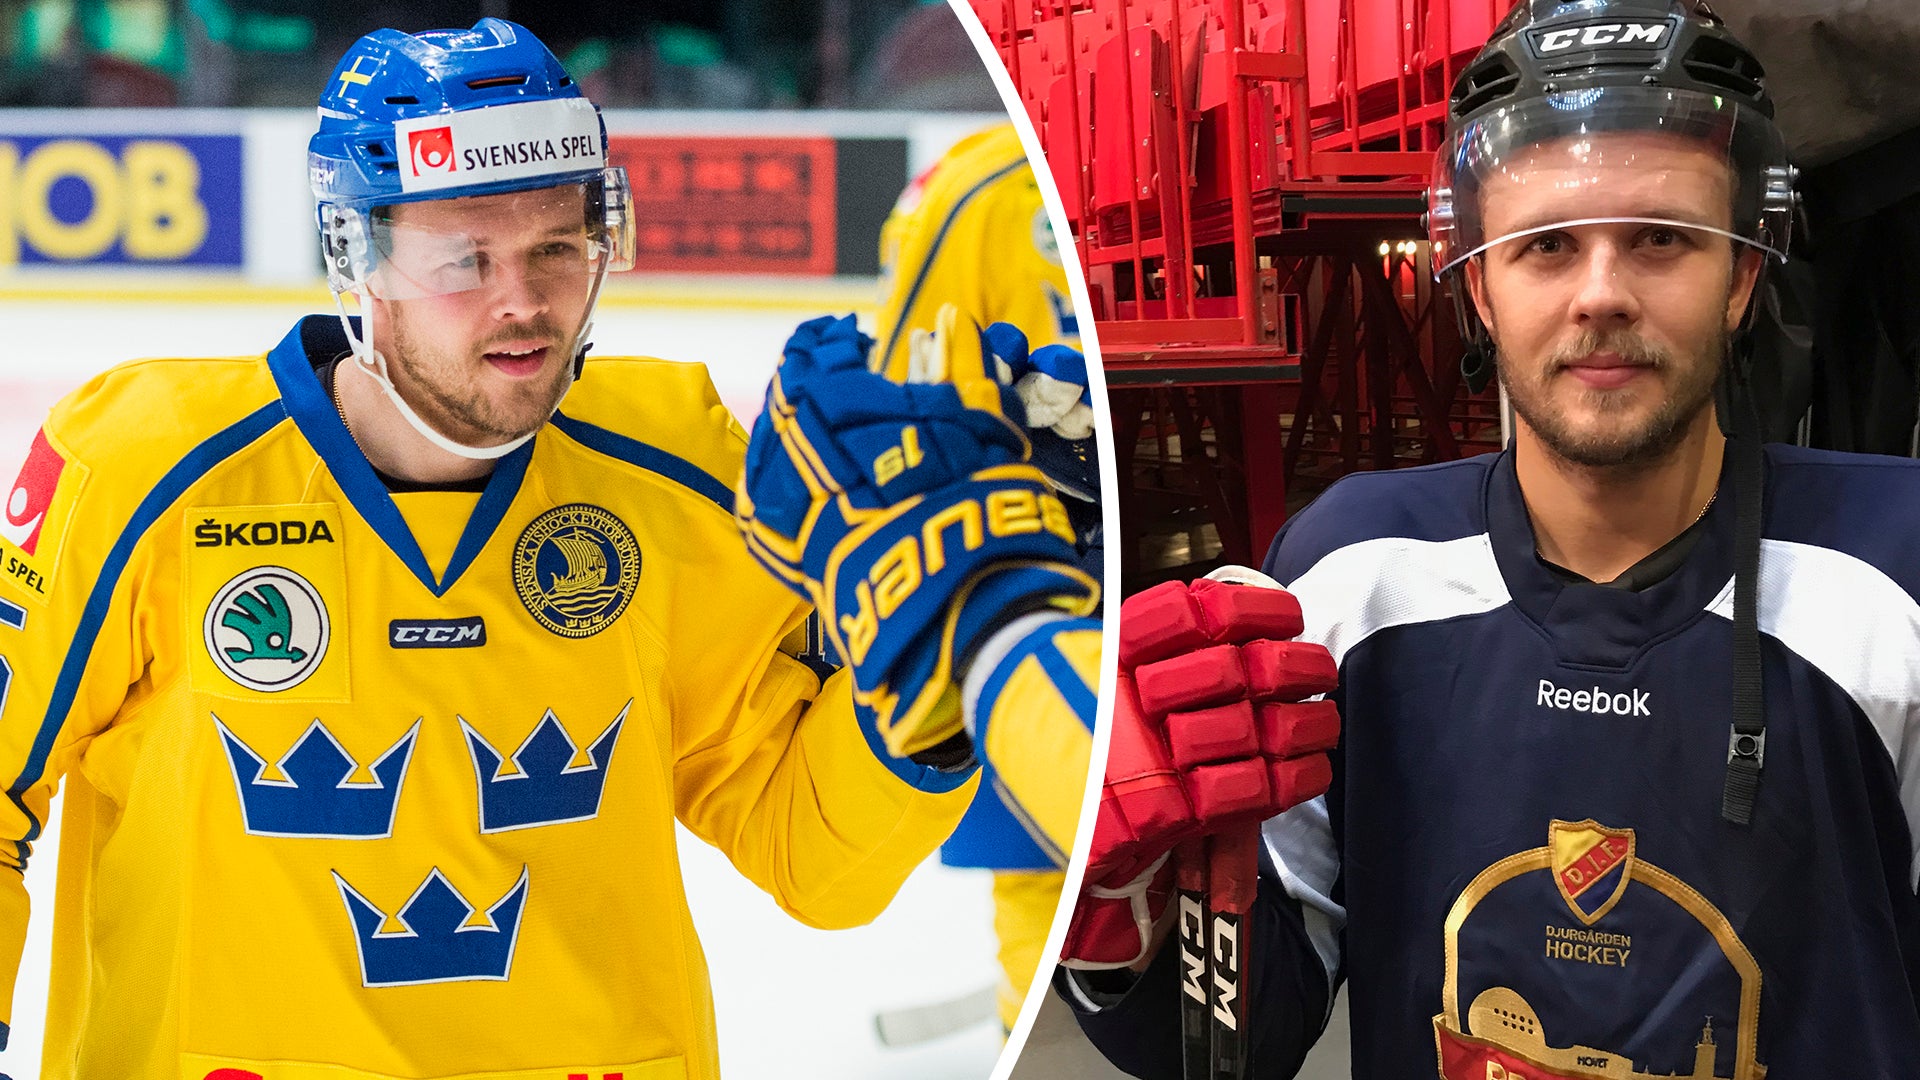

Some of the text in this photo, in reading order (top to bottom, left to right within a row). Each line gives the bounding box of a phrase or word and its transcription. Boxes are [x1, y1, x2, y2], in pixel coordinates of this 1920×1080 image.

[1540, 23, 1666, 52] CCM
[464, 135, 596, 171] SVENSKA SPEL
[195, 519, 334, 547] ŠKODA
[6, 557, 45, 594] SPEL
[522, 548, 548, 611] SVENSKA
[394, 624, 482, 642] CCM
[1537, 679, 1651, 717] Reebok
[1546, 925, 1631, 947] DJURGÅRDEN
[1546, 939, 1631, 968] HOCKEY
